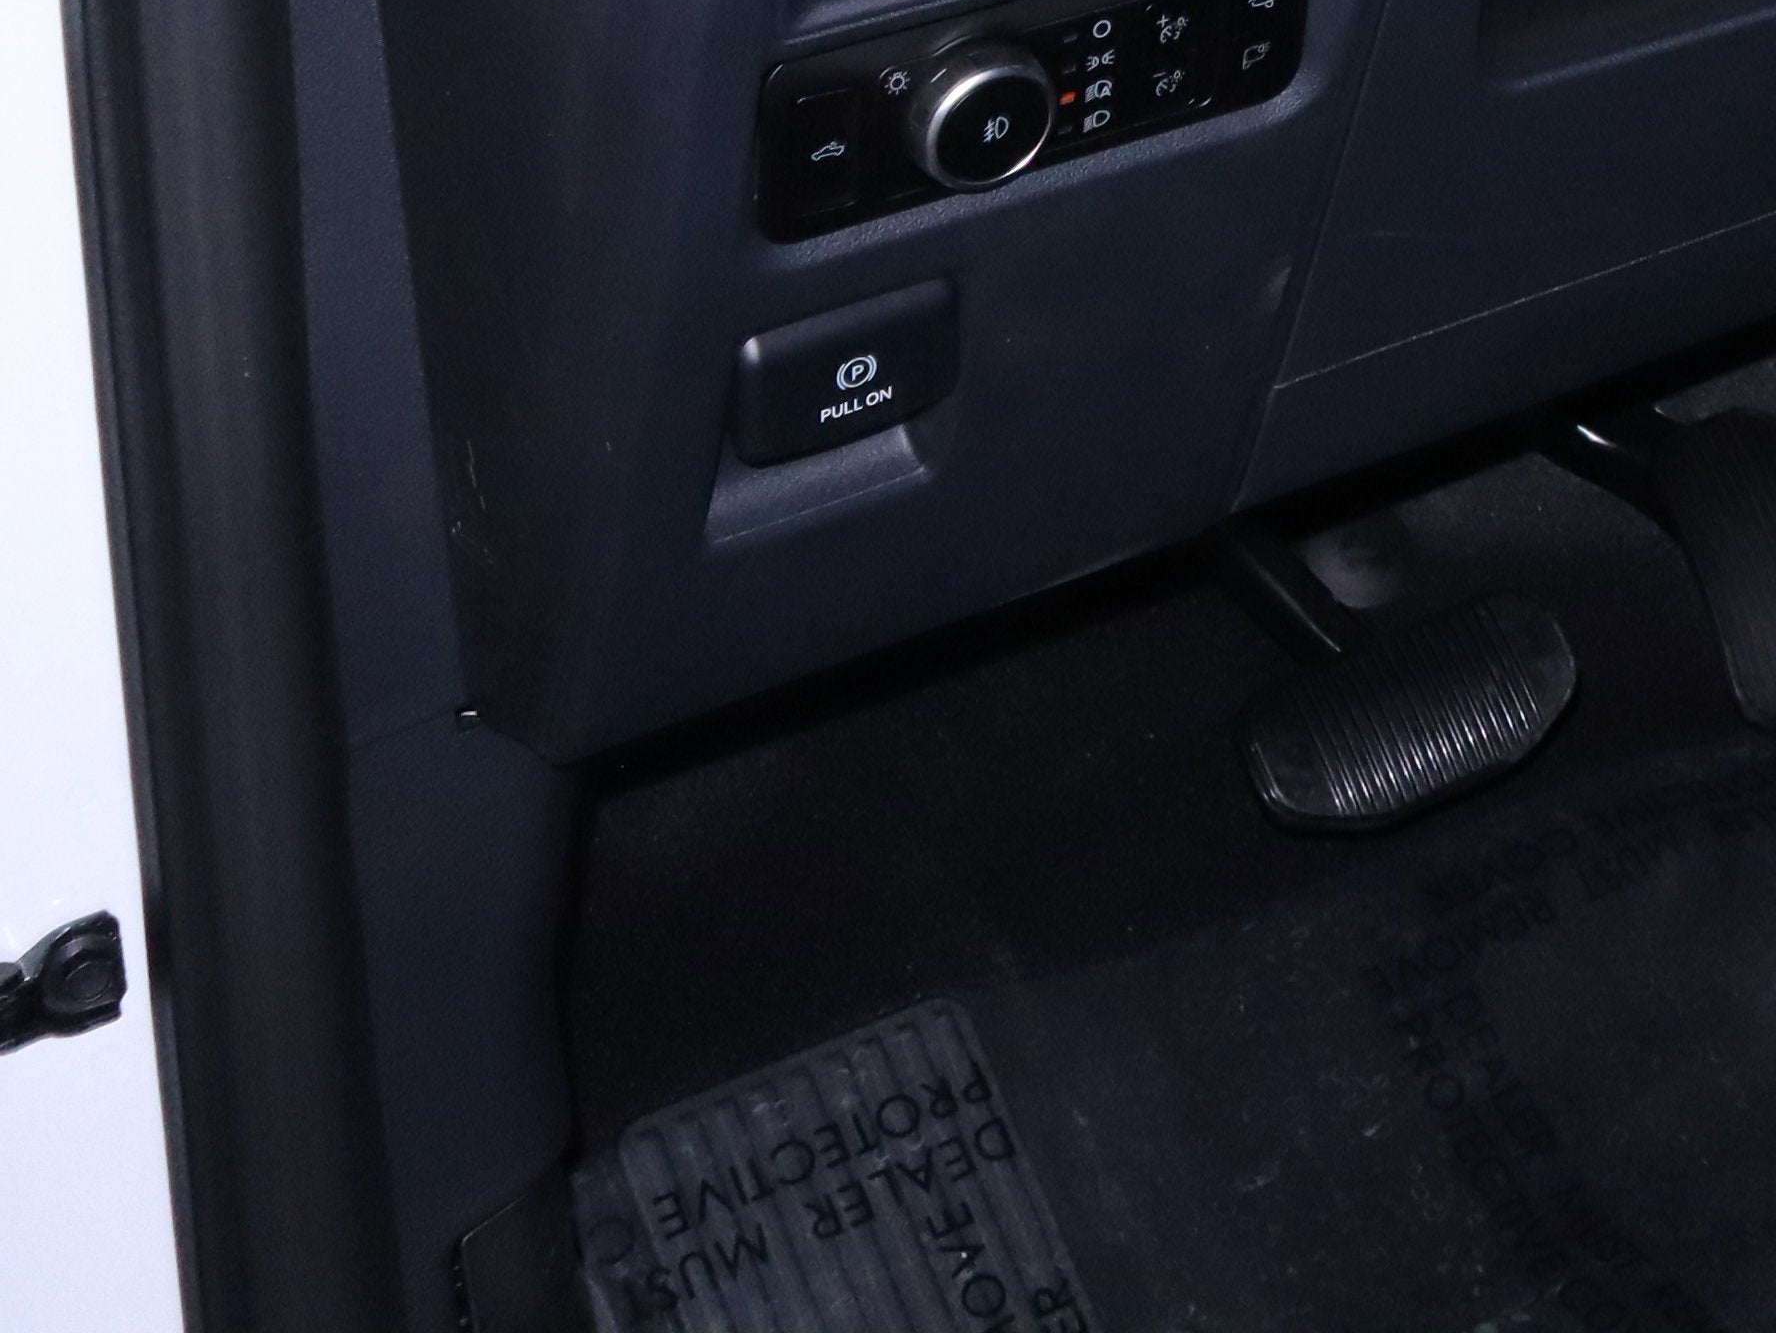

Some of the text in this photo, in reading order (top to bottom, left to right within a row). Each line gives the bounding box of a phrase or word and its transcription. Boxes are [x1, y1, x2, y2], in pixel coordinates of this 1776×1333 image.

[820, 385, 893, 423] PULL ON
[652, 1060, 993, 1241] PROTECTIVE
[802, 1116, 1018, 1241] DEALER
